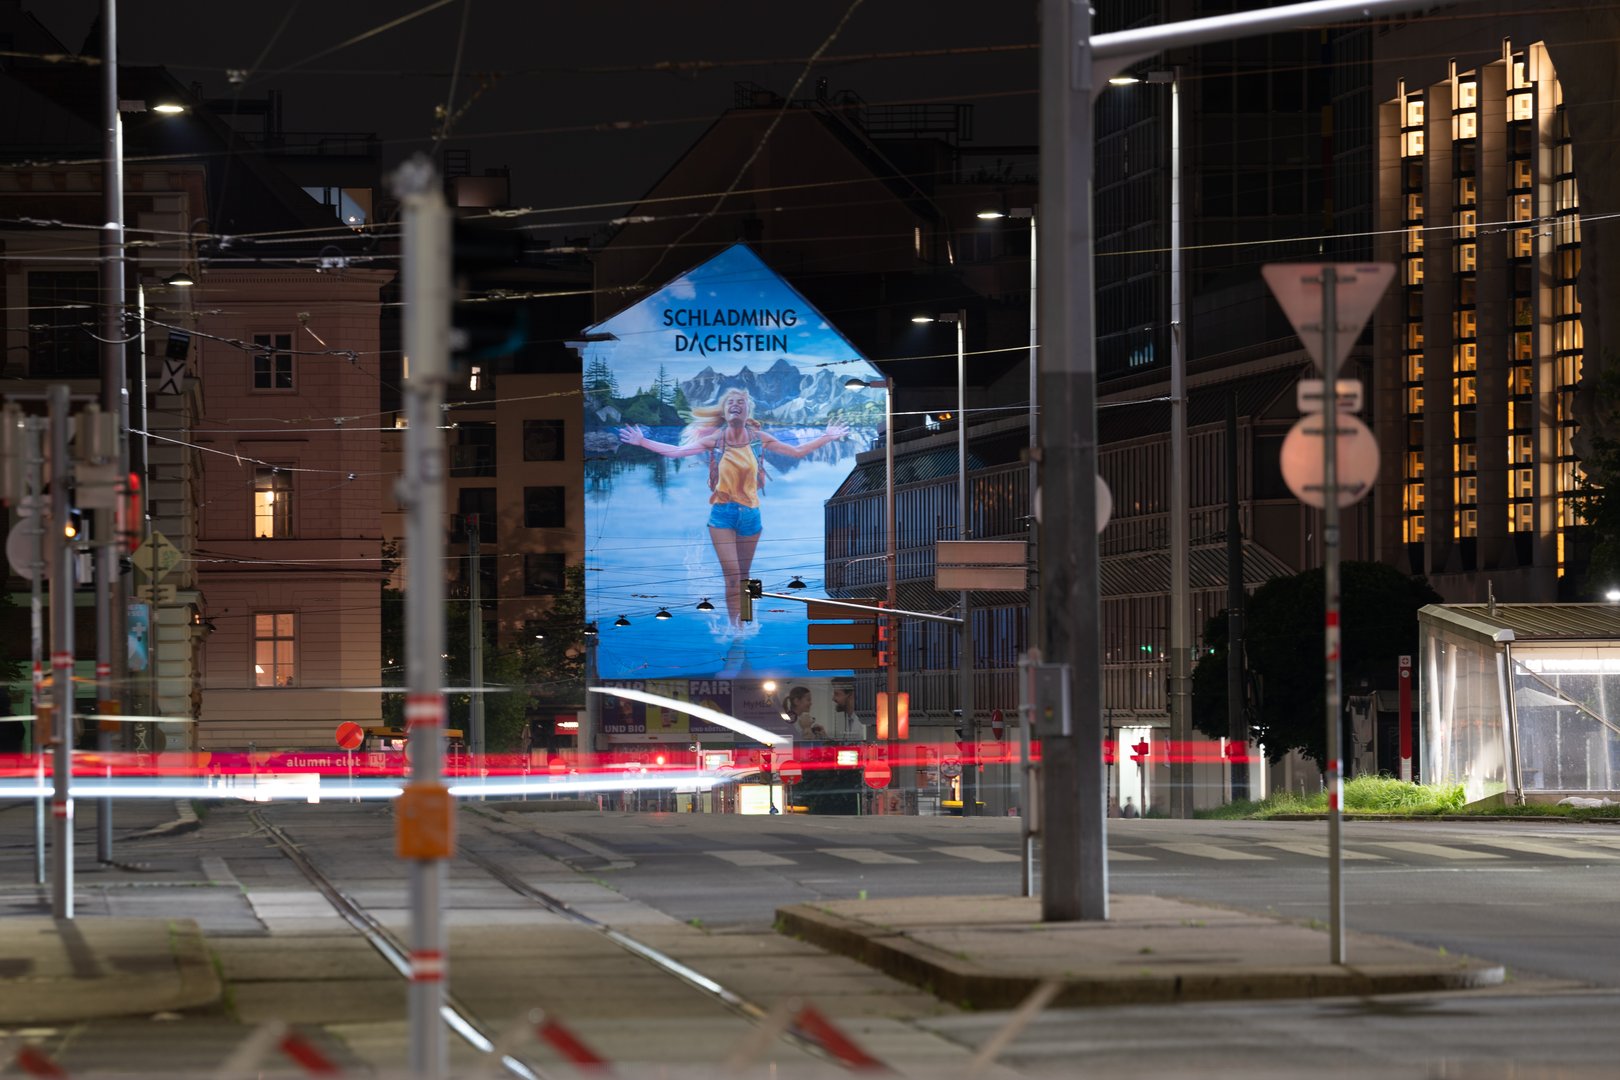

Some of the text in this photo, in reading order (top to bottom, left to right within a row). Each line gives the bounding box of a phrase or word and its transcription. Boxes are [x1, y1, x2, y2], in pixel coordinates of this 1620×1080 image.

[663, 308, 797, 328] SCHLADMING
[675, 332, 787, 357] DACHSTEIN
[690, 681, 731, 695] FAIR
[605, 724, 626, 733] UND
[628, 724, 645, 733] BIO
[286, 756, 331, 767] alumni
